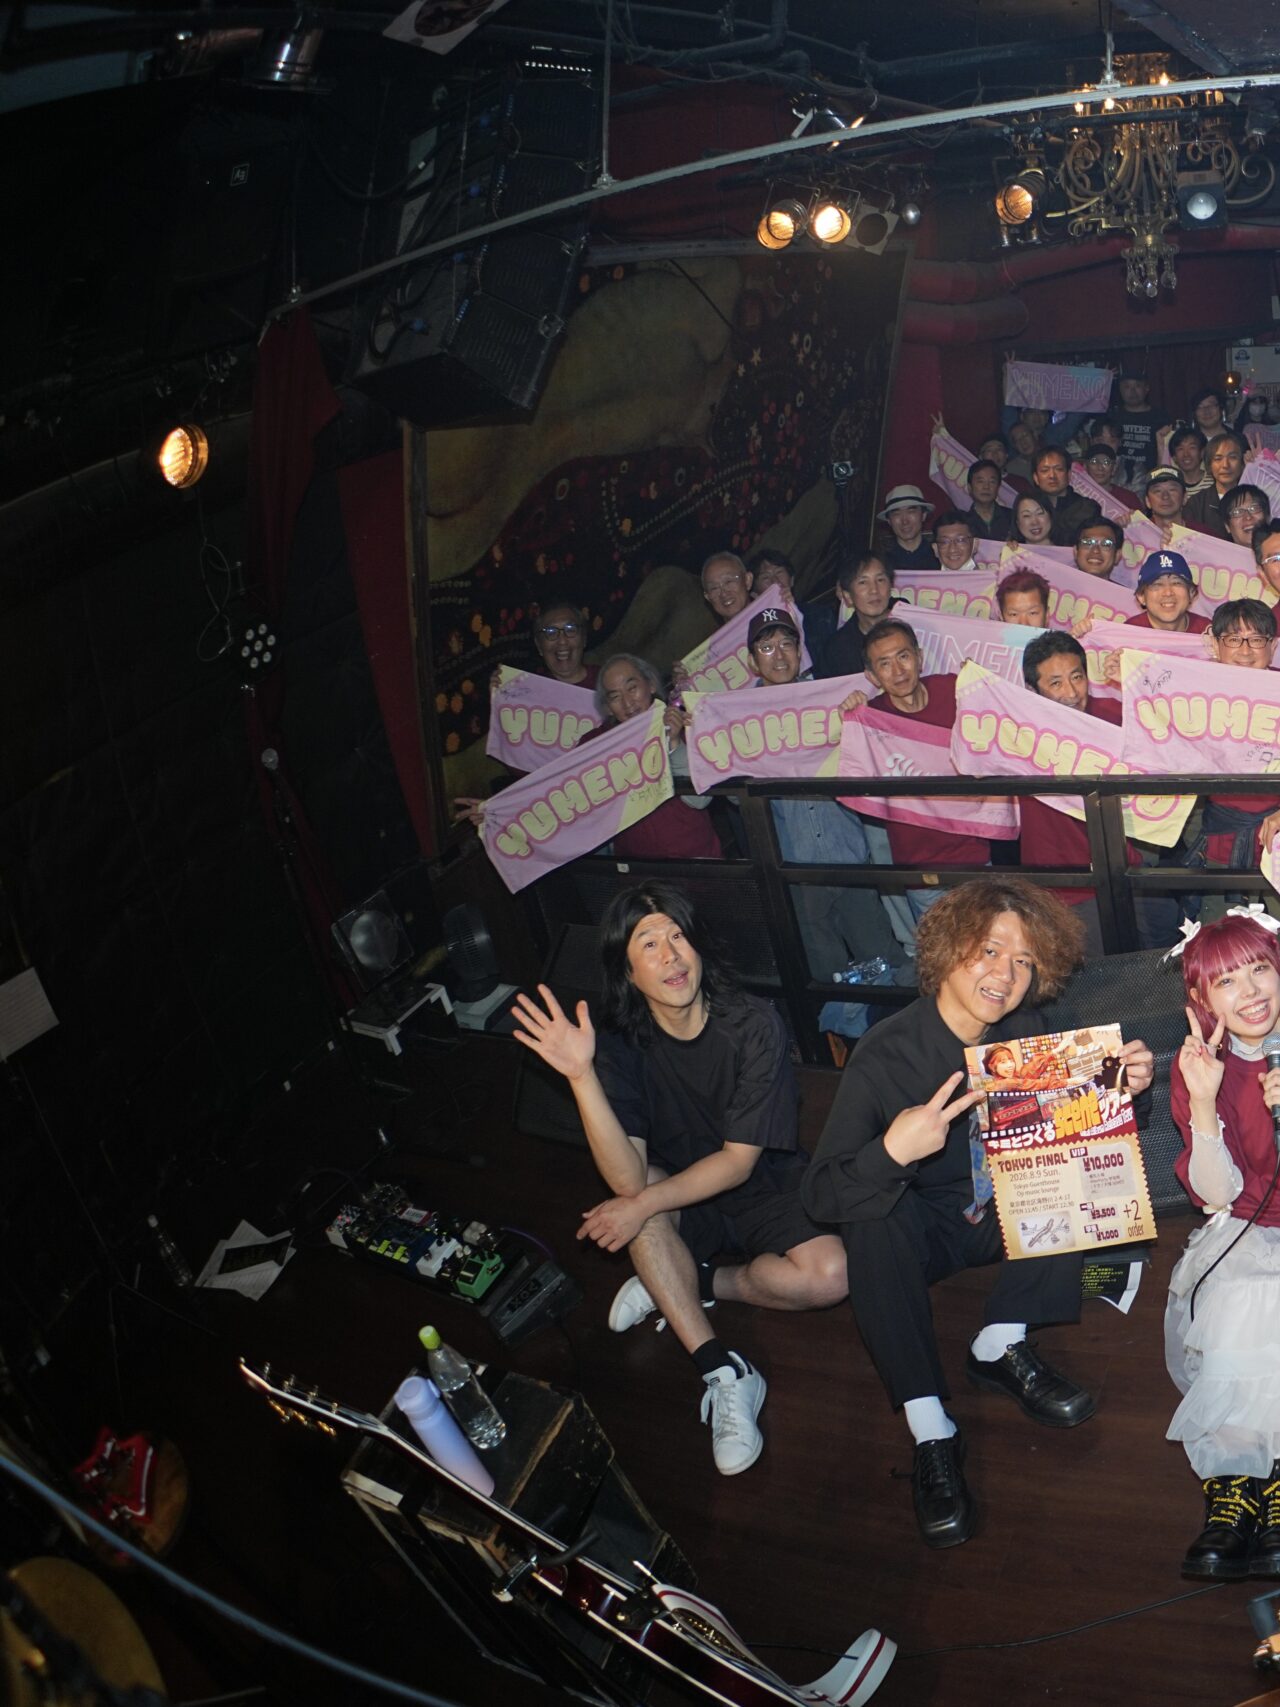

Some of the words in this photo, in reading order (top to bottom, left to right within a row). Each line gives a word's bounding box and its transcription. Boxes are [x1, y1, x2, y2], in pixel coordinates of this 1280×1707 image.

[494, 736, 667, 860] YUMENO
[997, 1157, 1034, 1173] TOKYO
[1035, 1152, 1069, 1168] FINAL
[1071, 1148, 1086, 1158] VIP
[1083, 1152, 1125, 1172] ¥10,000
[1127, 1222, 1144, 1237] order
